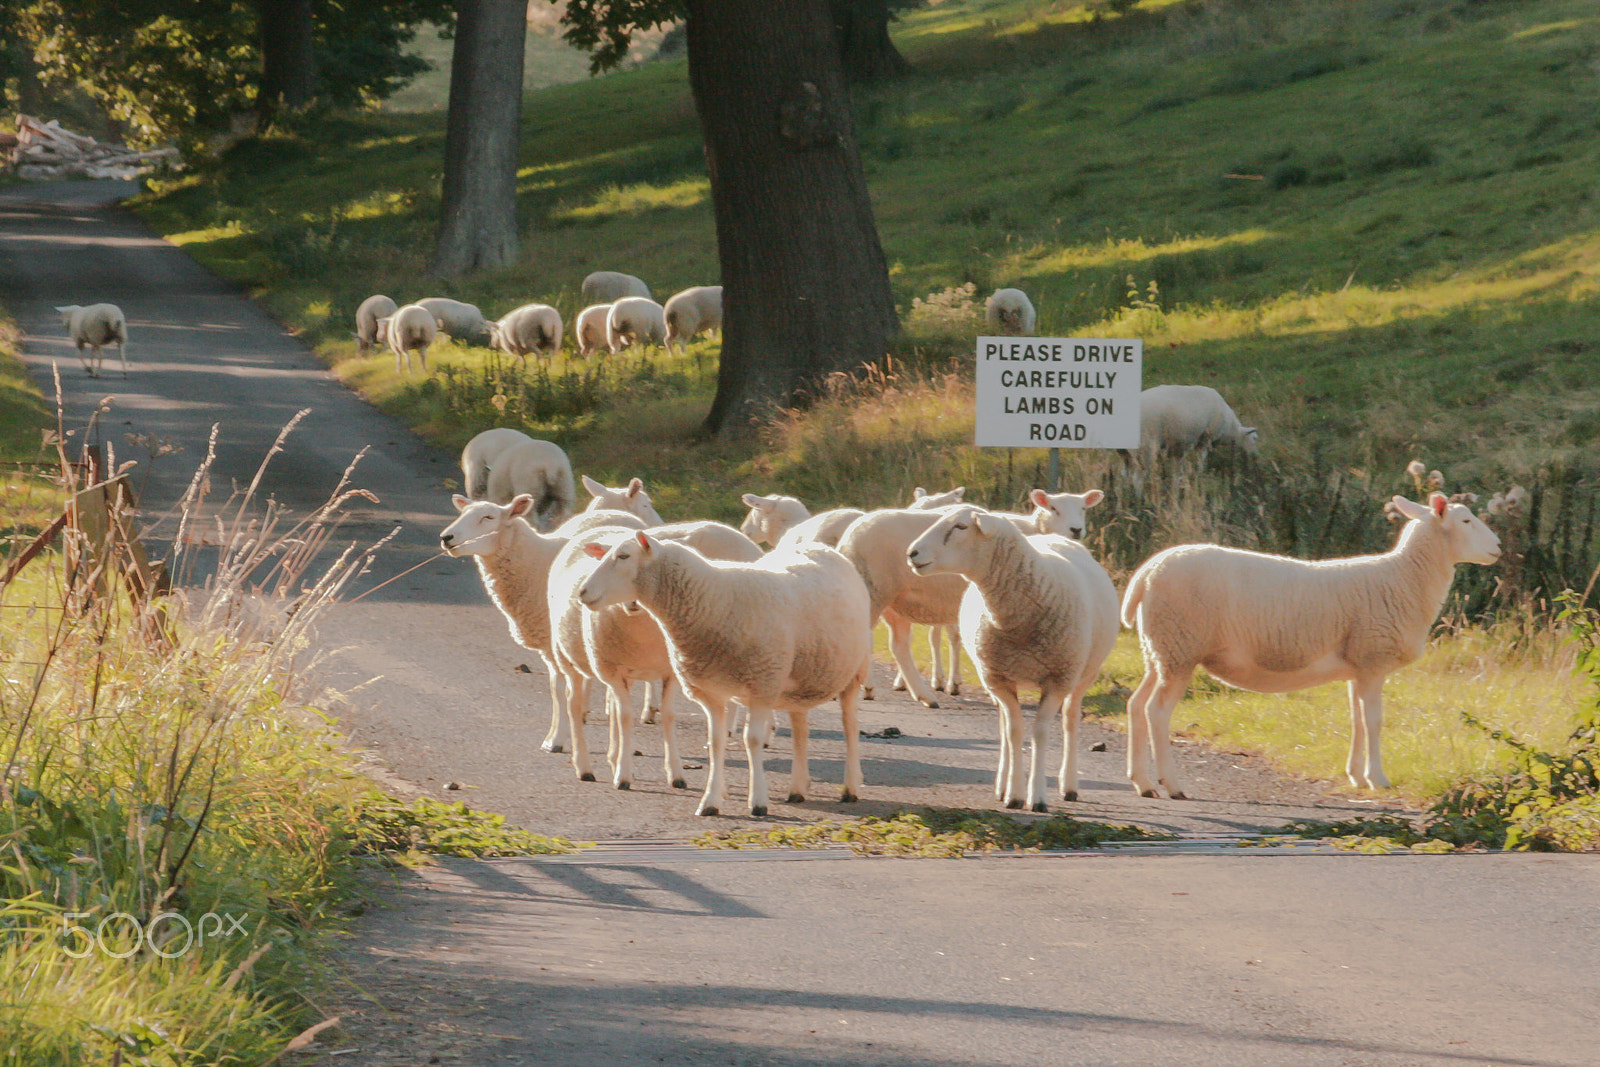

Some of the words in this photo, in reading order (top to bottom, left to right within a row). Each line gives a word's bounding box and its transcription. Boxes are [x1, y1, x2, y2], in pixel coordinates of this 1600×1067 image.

[985, 343, 1063, 362] PLEASE
[1073, 344, 1134, 363] DRIVE
[1001, 369, 1117, 389] CAREFULLY
[1004, 396, 1075, 415] LAMBS
[1085, 397, 1114, 416] ON
[1029, 422, 1087, 442] ROAD
